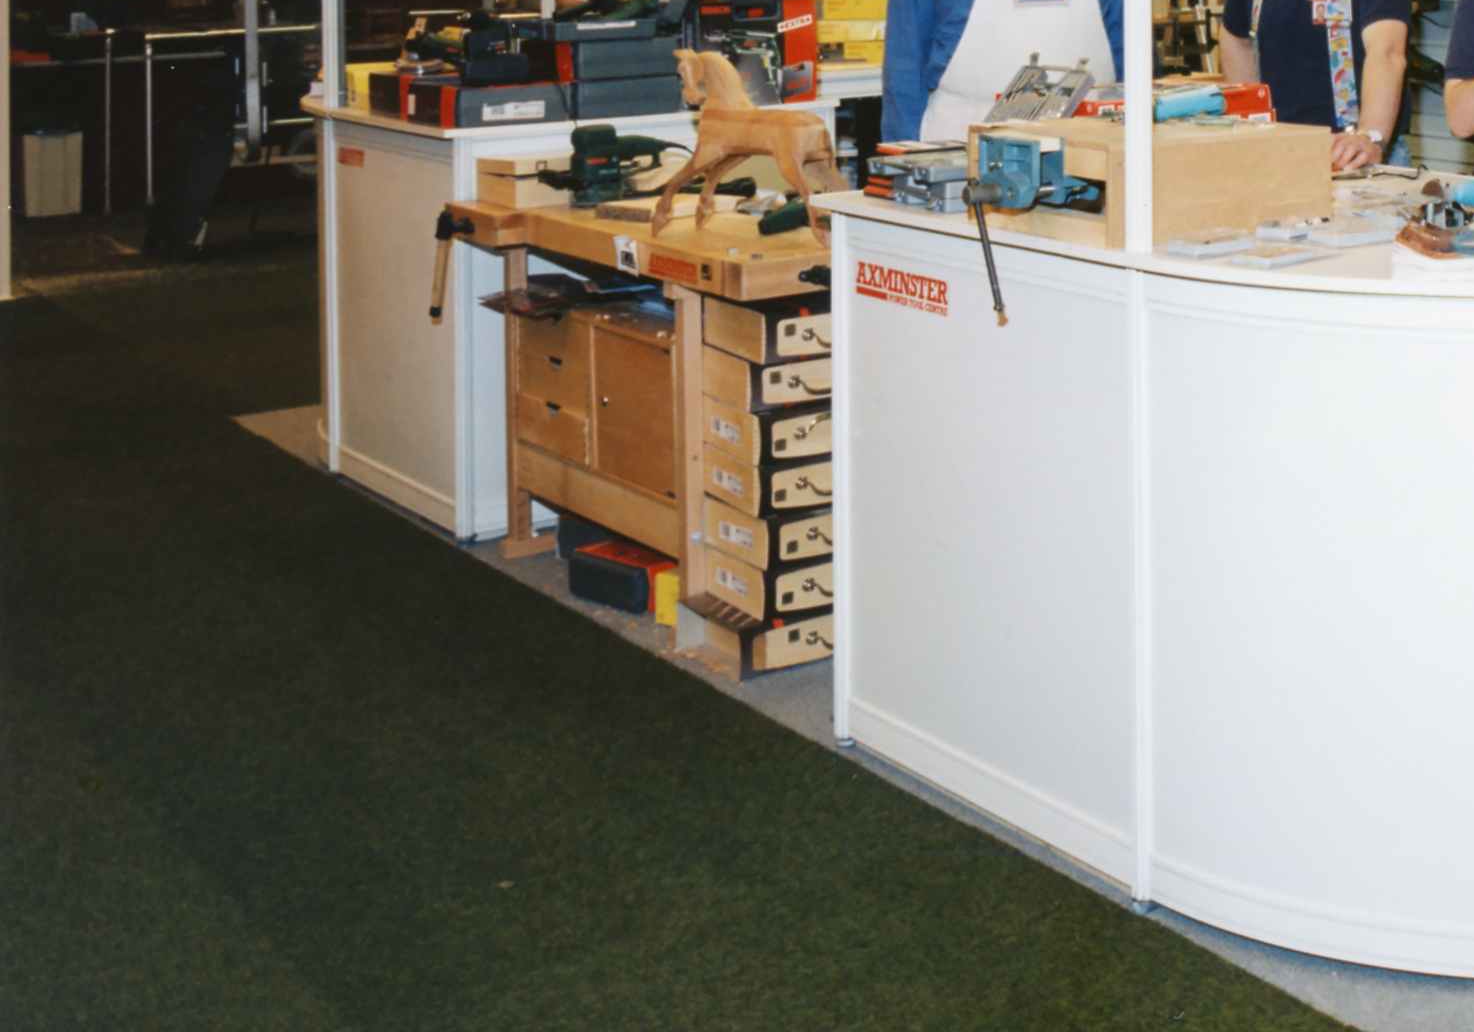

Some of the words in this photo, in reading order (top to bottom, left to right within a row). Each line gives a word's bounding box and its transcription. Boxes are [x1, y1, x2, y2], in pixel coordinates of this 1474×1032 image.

[701, 6, 731, 15] BOSCH
[856, 261, 948, 305] AXMINSTER
[889, 293, 908, 306] POWER
[909, 299, 924, 310] TOOL
[925, 302, 948, 316] CENTRE
